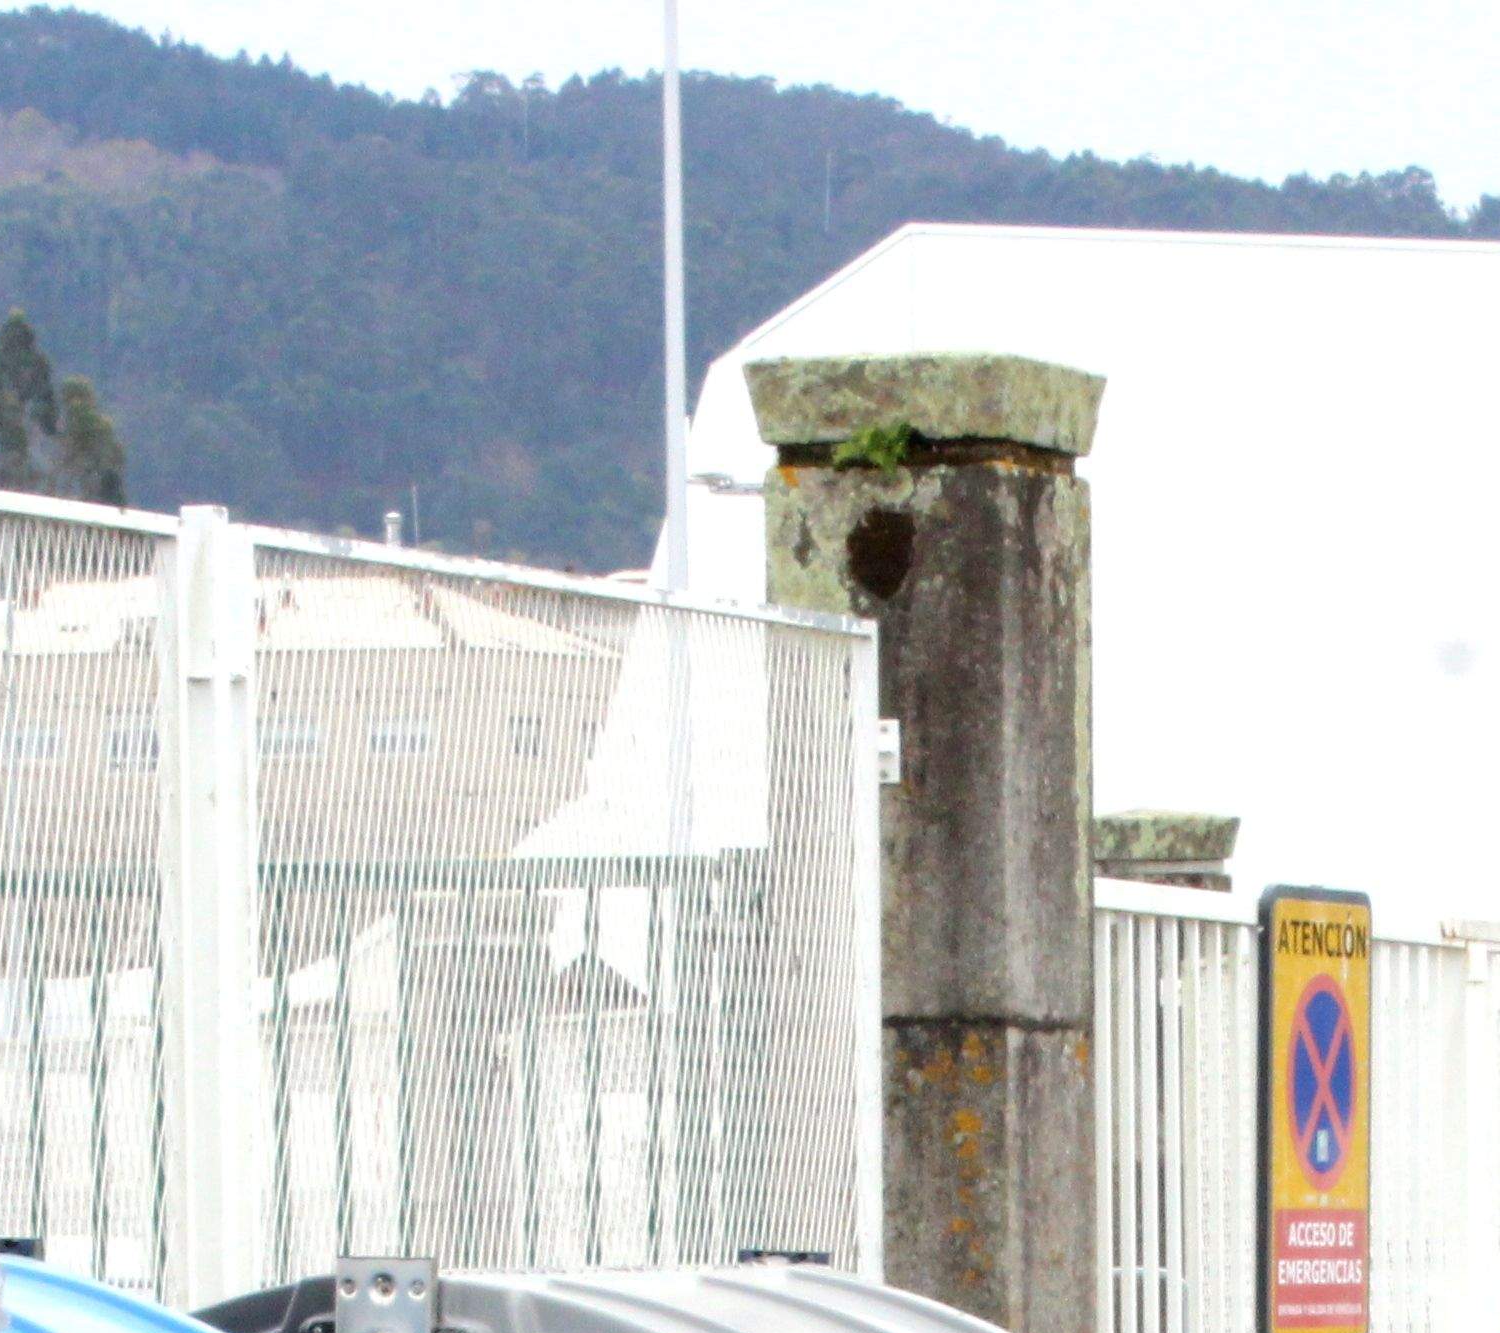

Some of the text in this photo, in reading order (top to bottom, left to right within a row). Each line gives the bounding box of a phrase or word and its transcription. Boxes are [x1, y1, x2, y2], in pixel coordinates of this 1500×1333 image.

[1277, 911, 1366, 958] ATENCIÓN
[1288, 1221, 1355, 1248] ACCESO DE
[1278, 1258, 1362, 1286] EMERGENCIAS
